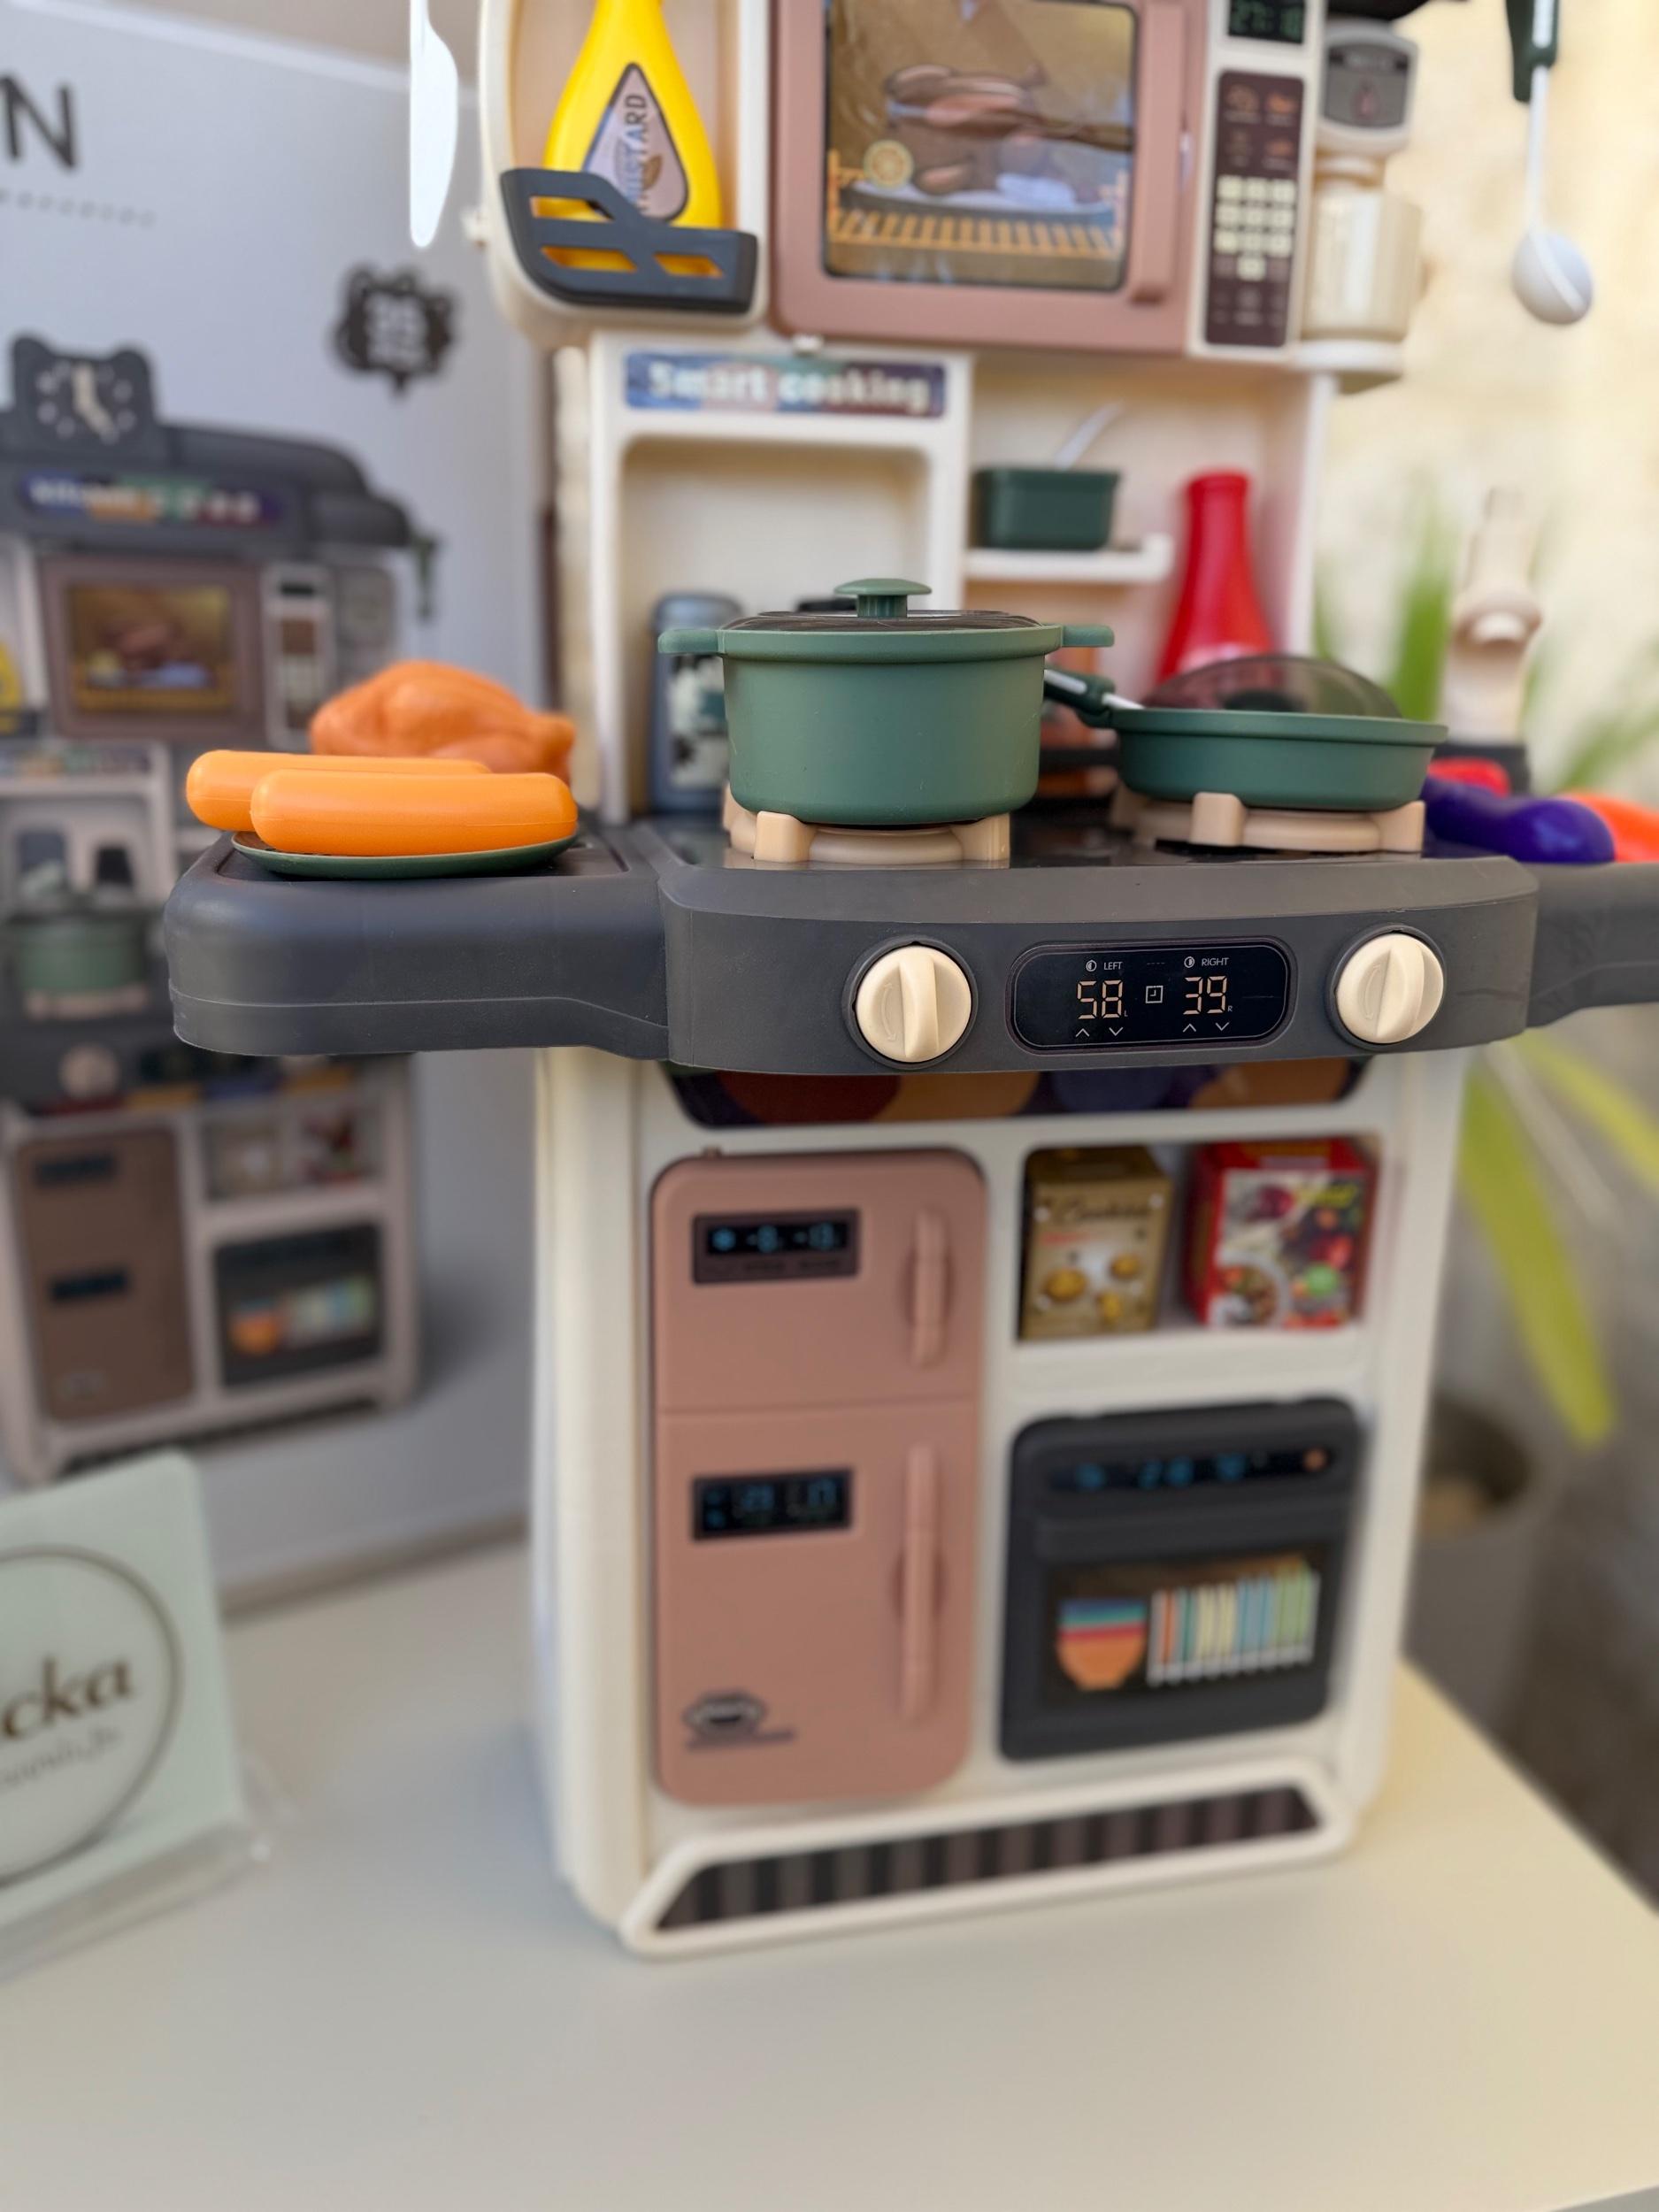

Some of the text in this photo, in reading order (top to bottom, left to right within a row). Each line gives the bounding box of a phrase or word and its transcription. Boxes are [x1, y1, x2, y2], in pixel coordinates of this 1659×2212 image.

[648, 361, 931, 416] Smart cooking
[1103, 957, 1229, 971] LEFT RIGHT
[1076, 979, 1124, 1019] 58
[1182, 975, 1228, 1015] 39
